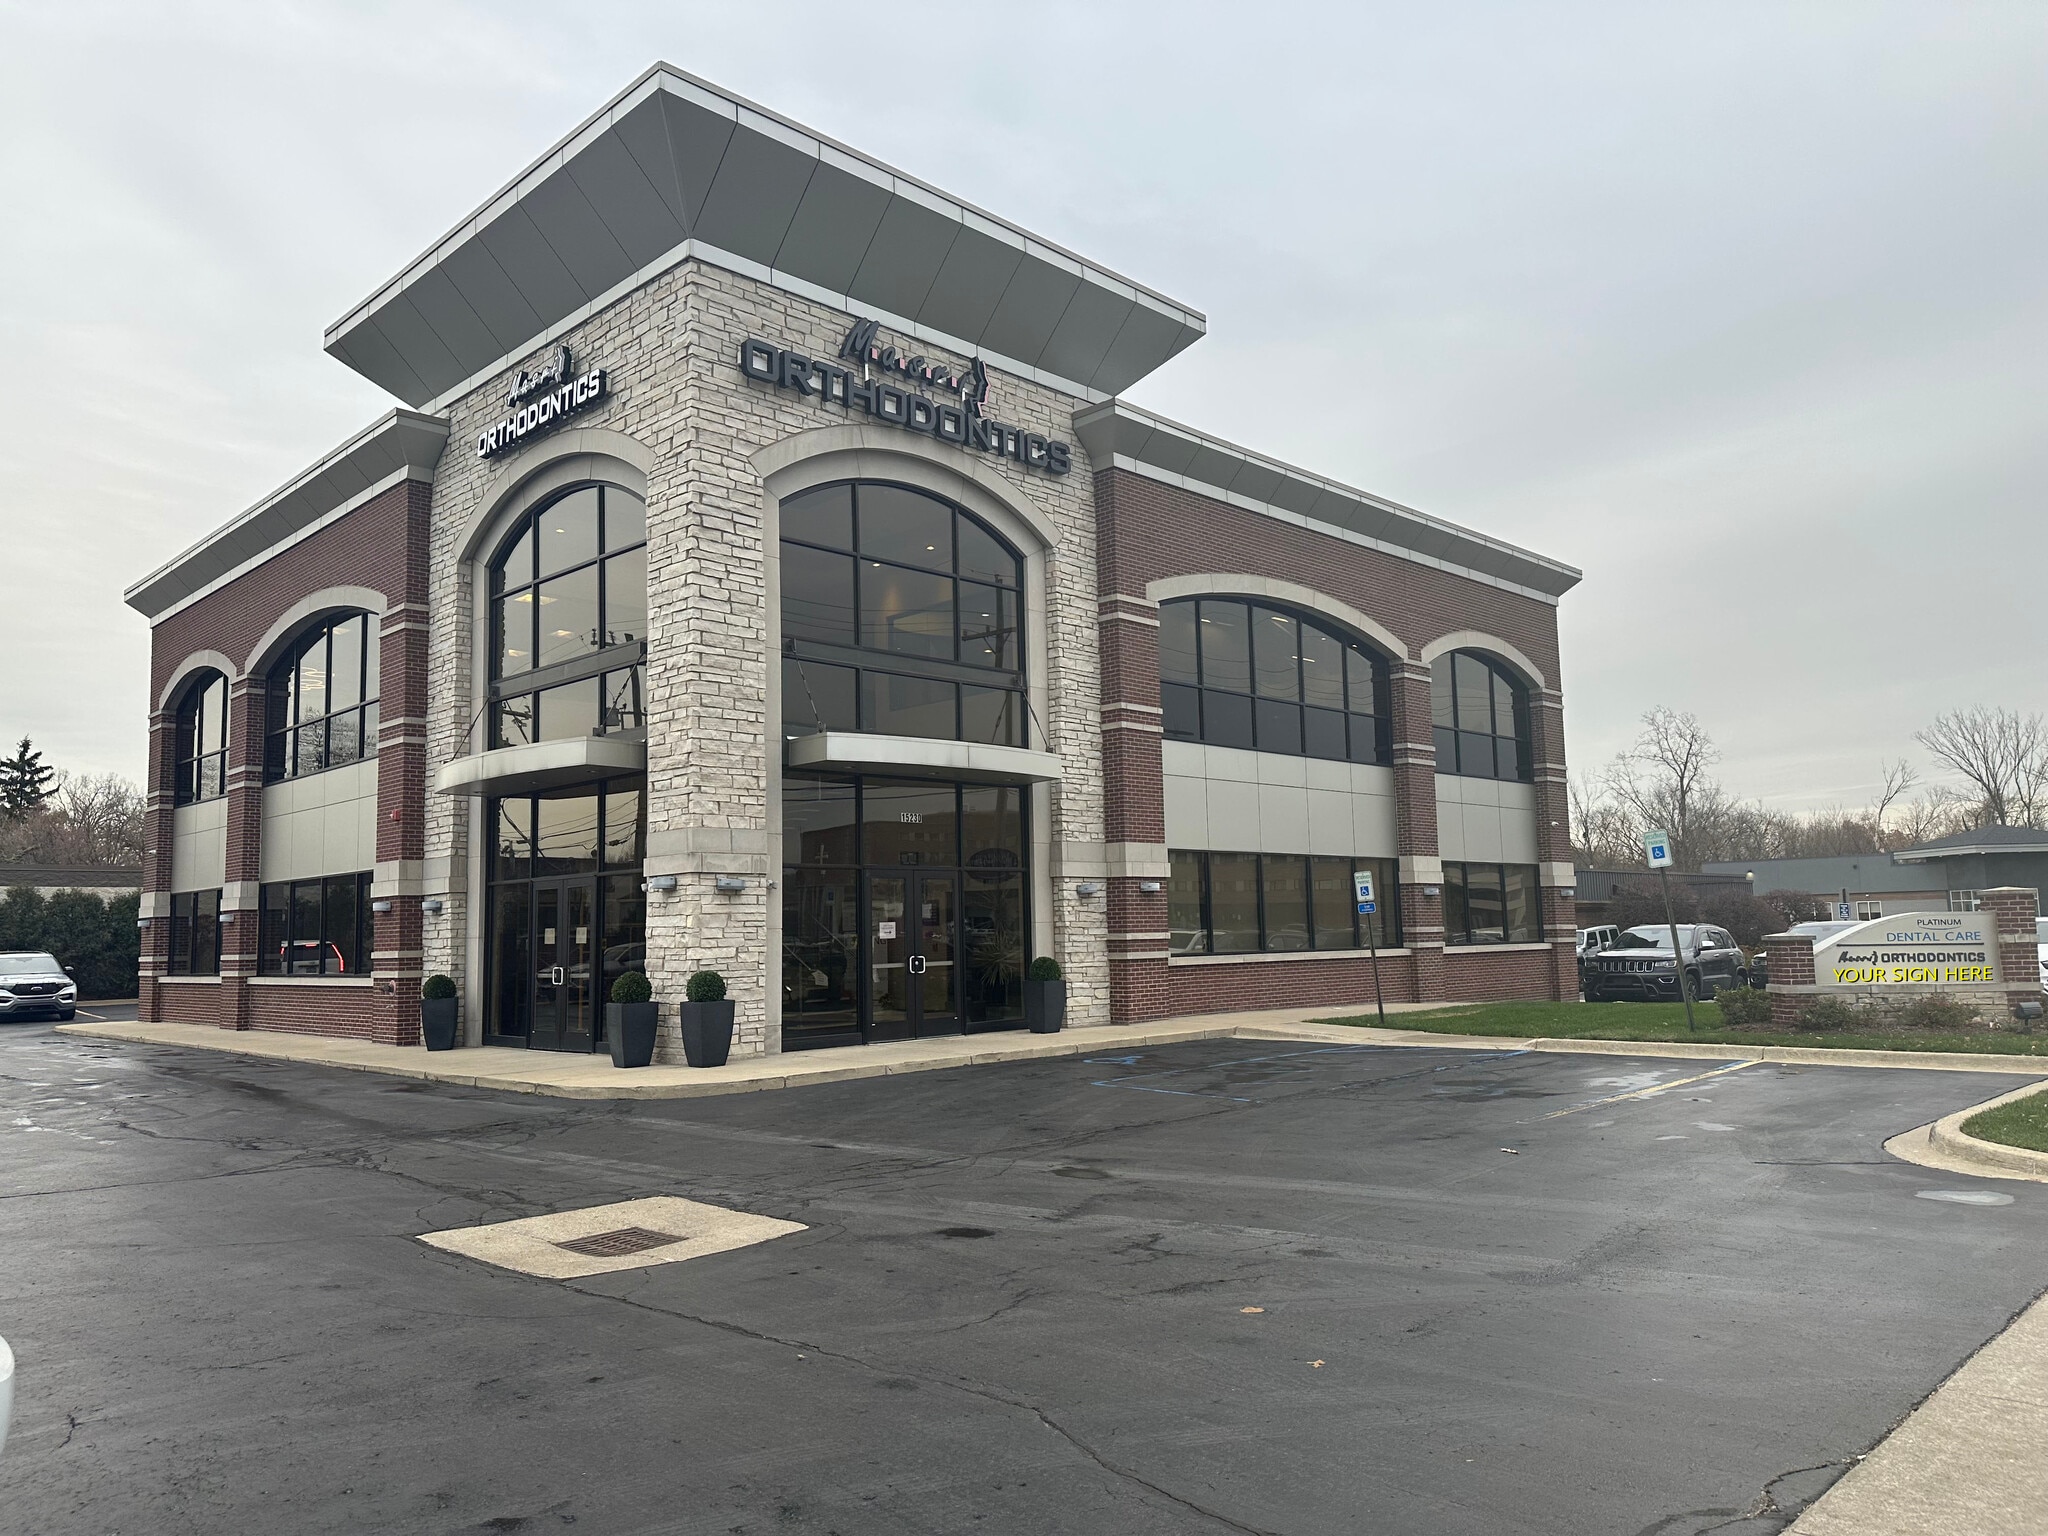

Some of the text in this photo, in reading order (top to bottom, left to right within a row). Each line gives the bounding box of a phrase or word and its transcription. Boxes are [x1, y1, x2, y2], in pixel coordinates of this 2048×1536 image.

[738, 337, 1072, 476] ORTHODONTICS
[477, 368, 606, 460] ORTHODONTICS
[901, 813, 923, 823] 15230
[1916, 918, 1962, 926] PLATINUM
[1886, 931, 1982, 942] DENTAL CARE
[1881, 952, 1986, 963] ORTHODONTICS
